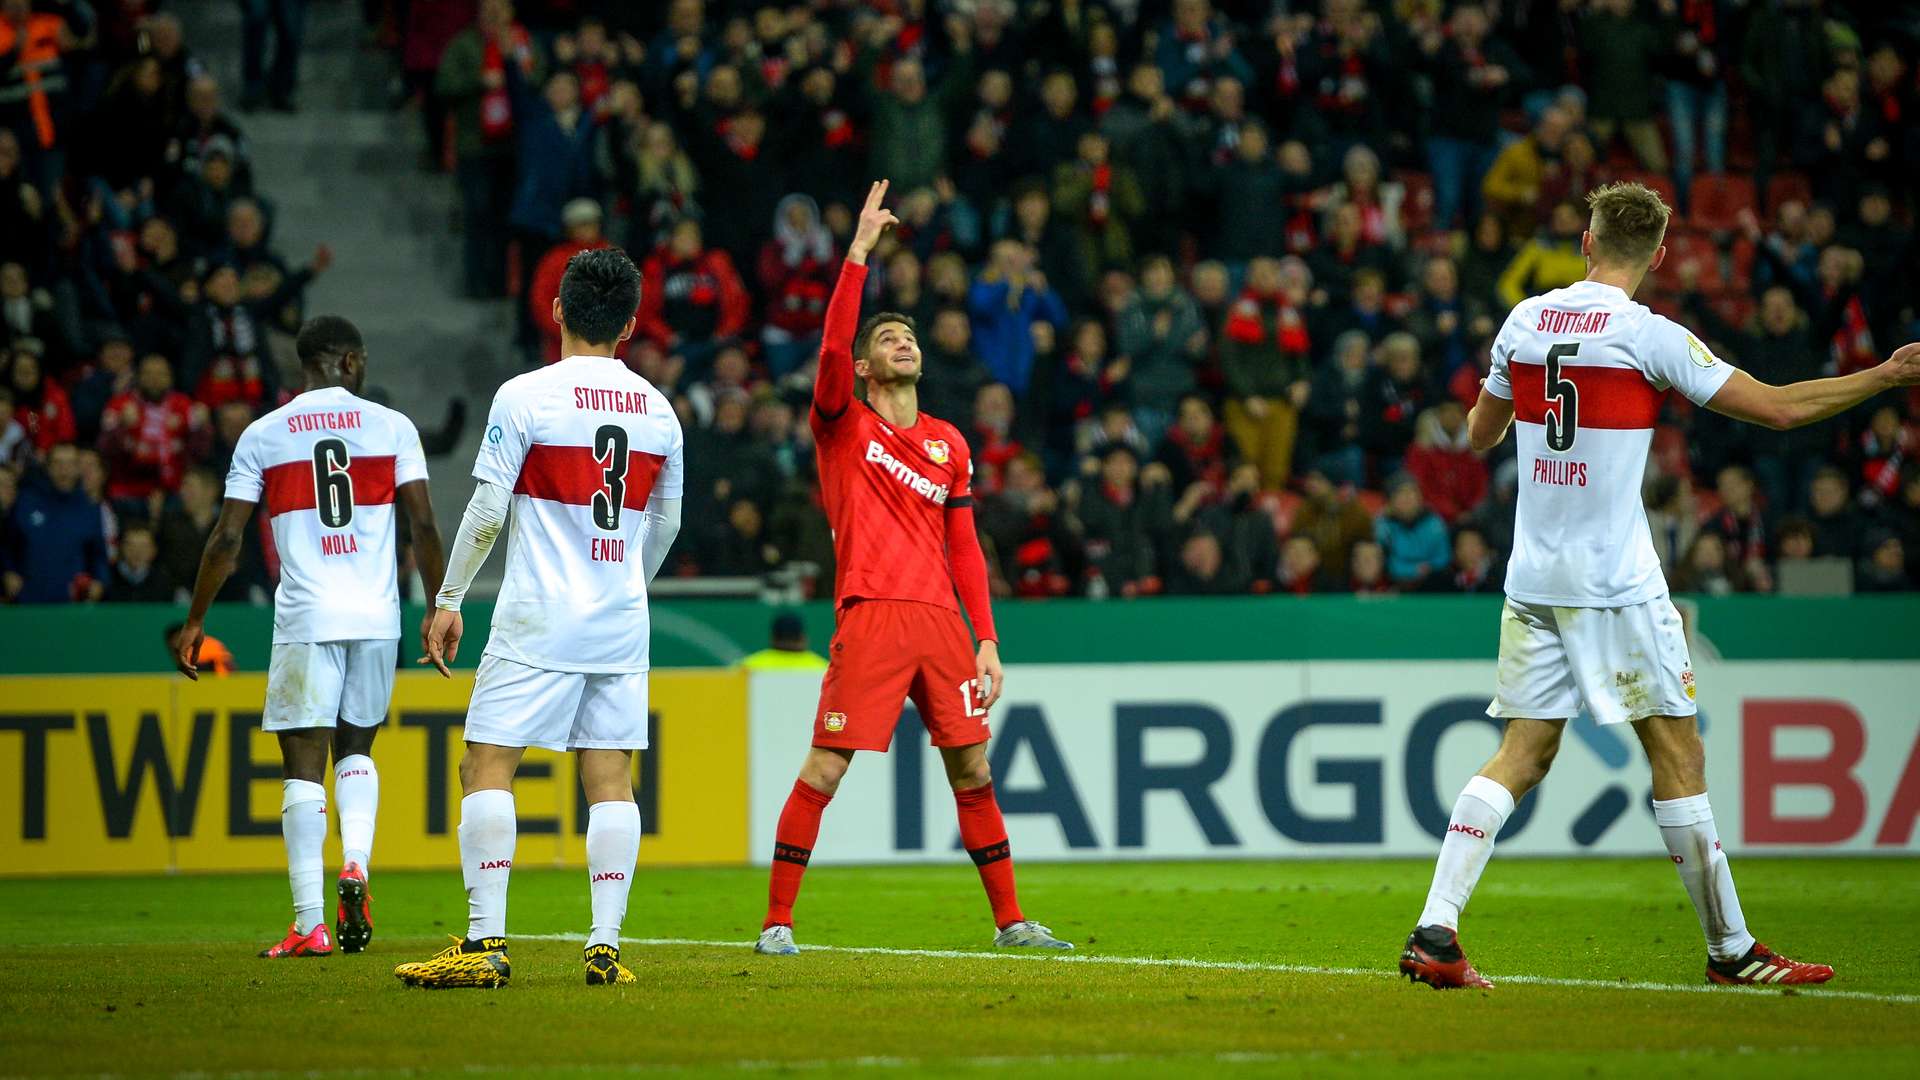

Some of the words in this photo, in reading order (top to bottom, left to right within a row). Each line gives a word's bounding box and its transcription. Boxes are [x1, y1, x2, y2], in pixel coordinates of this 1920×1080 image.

[1537, 309, 1611, 334] STUTTGART
[574, 386, 648, 415] STUTTGART
[1544, 342, 1580, 452] 5
[287, 411, 361, 433] STUTTGART
[312, 437, 354, 529] 6
[591, 423, 629, 532] 3
[1533, 458, 1588, 487] PHILLIPS
[321, 533, 358, 556] MOLA
[591, 537, 625, 563] ENDO
[0, 711, 657, 840] TWETN
[1448, 823, 1485, 839] JAKO
[479, 859, 511, 870] JAKO
[592, 872, 625, 883] JAKO
